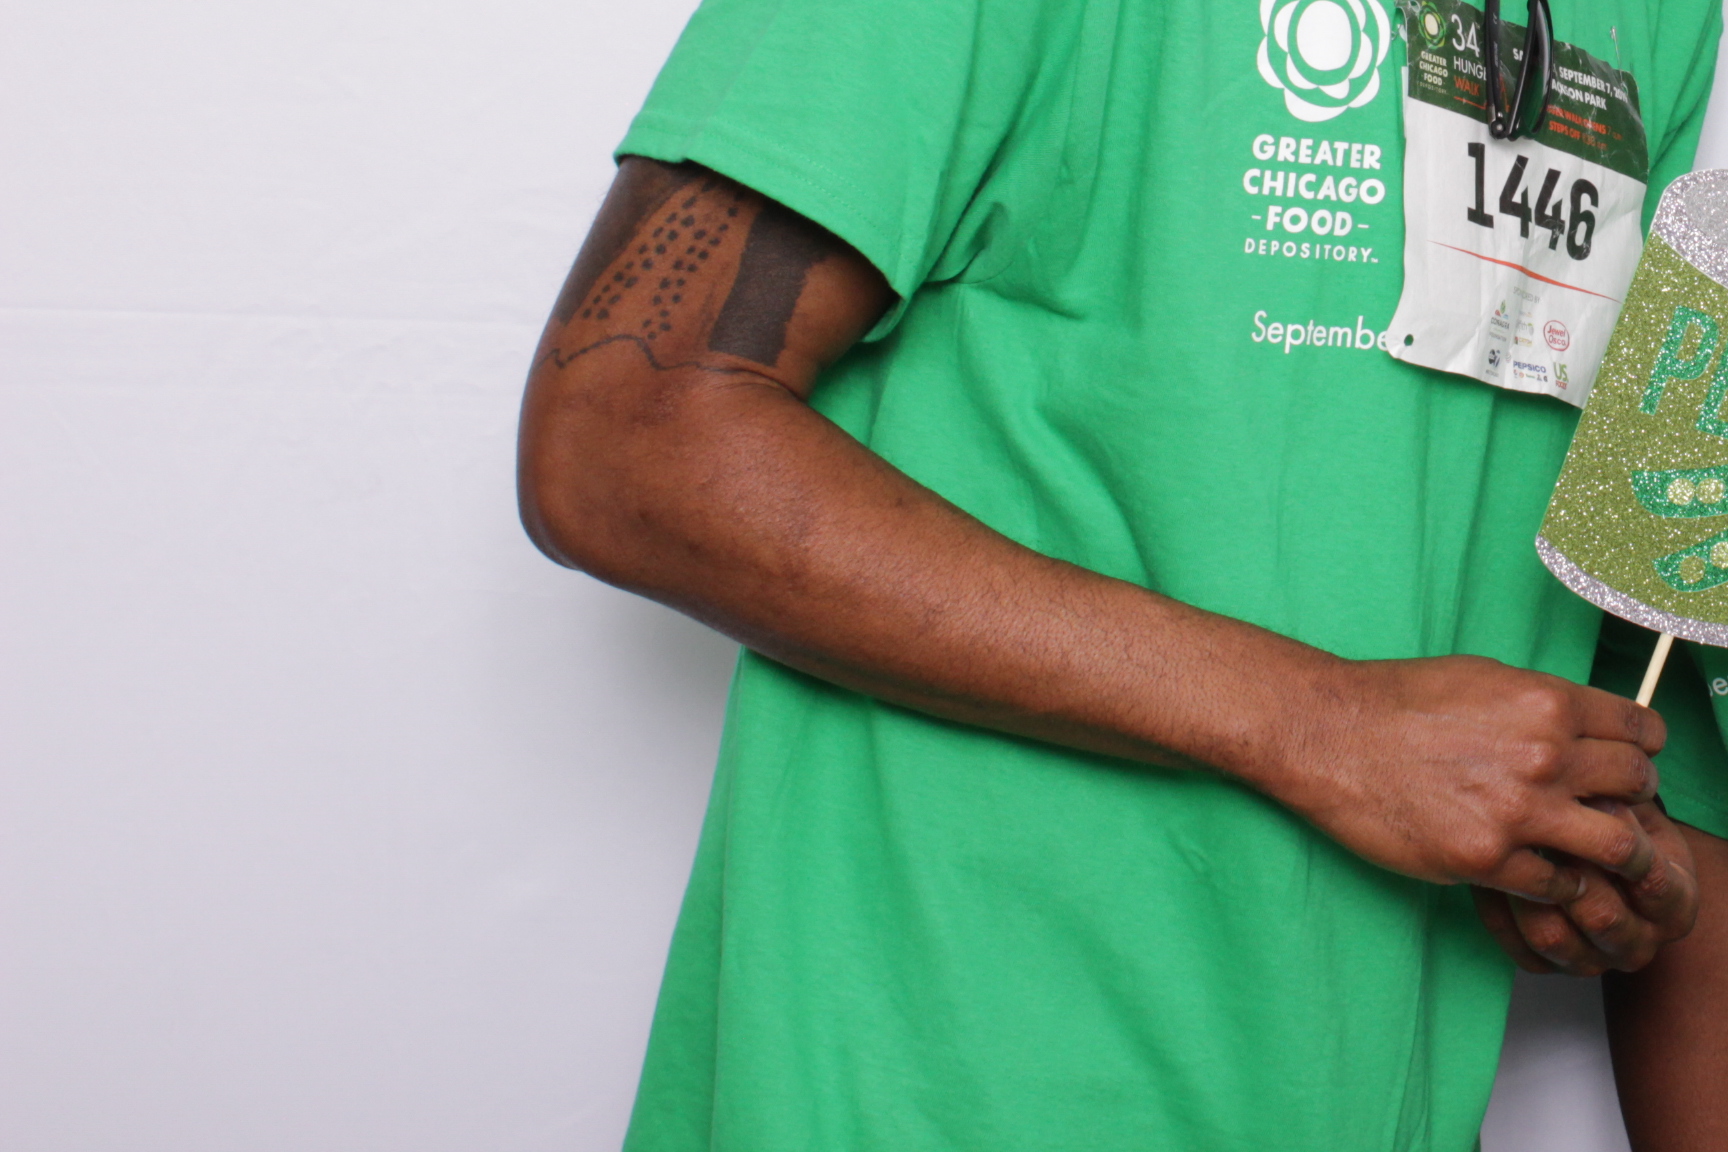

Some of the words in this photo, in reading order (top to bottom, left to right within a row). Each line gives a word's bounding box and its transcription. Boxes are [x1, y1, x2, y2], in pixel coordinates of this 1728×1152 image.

[1419, 60, 1449, 78] CHICAGO
[1420, 50, 1448, 67] GREATER
[1423, 72, 1443, 86] FOOD
[1559, 66, 1605, 94] SEPTEMBER
[1551, 78, 1584, 103] ACKSON
[1584, 92, 1607, 111] PARK
[1252, 133, 1382, 170] GREATER
[1243, 168, 1386, 205] CHICAGO
[1467, 142, 1599, 261] 1446
[1251, 310, 1388, 354] Septembe
[1547, 325, 1566, 337] Jewel
[1513, 360, 1547, 374] PEPSICO
